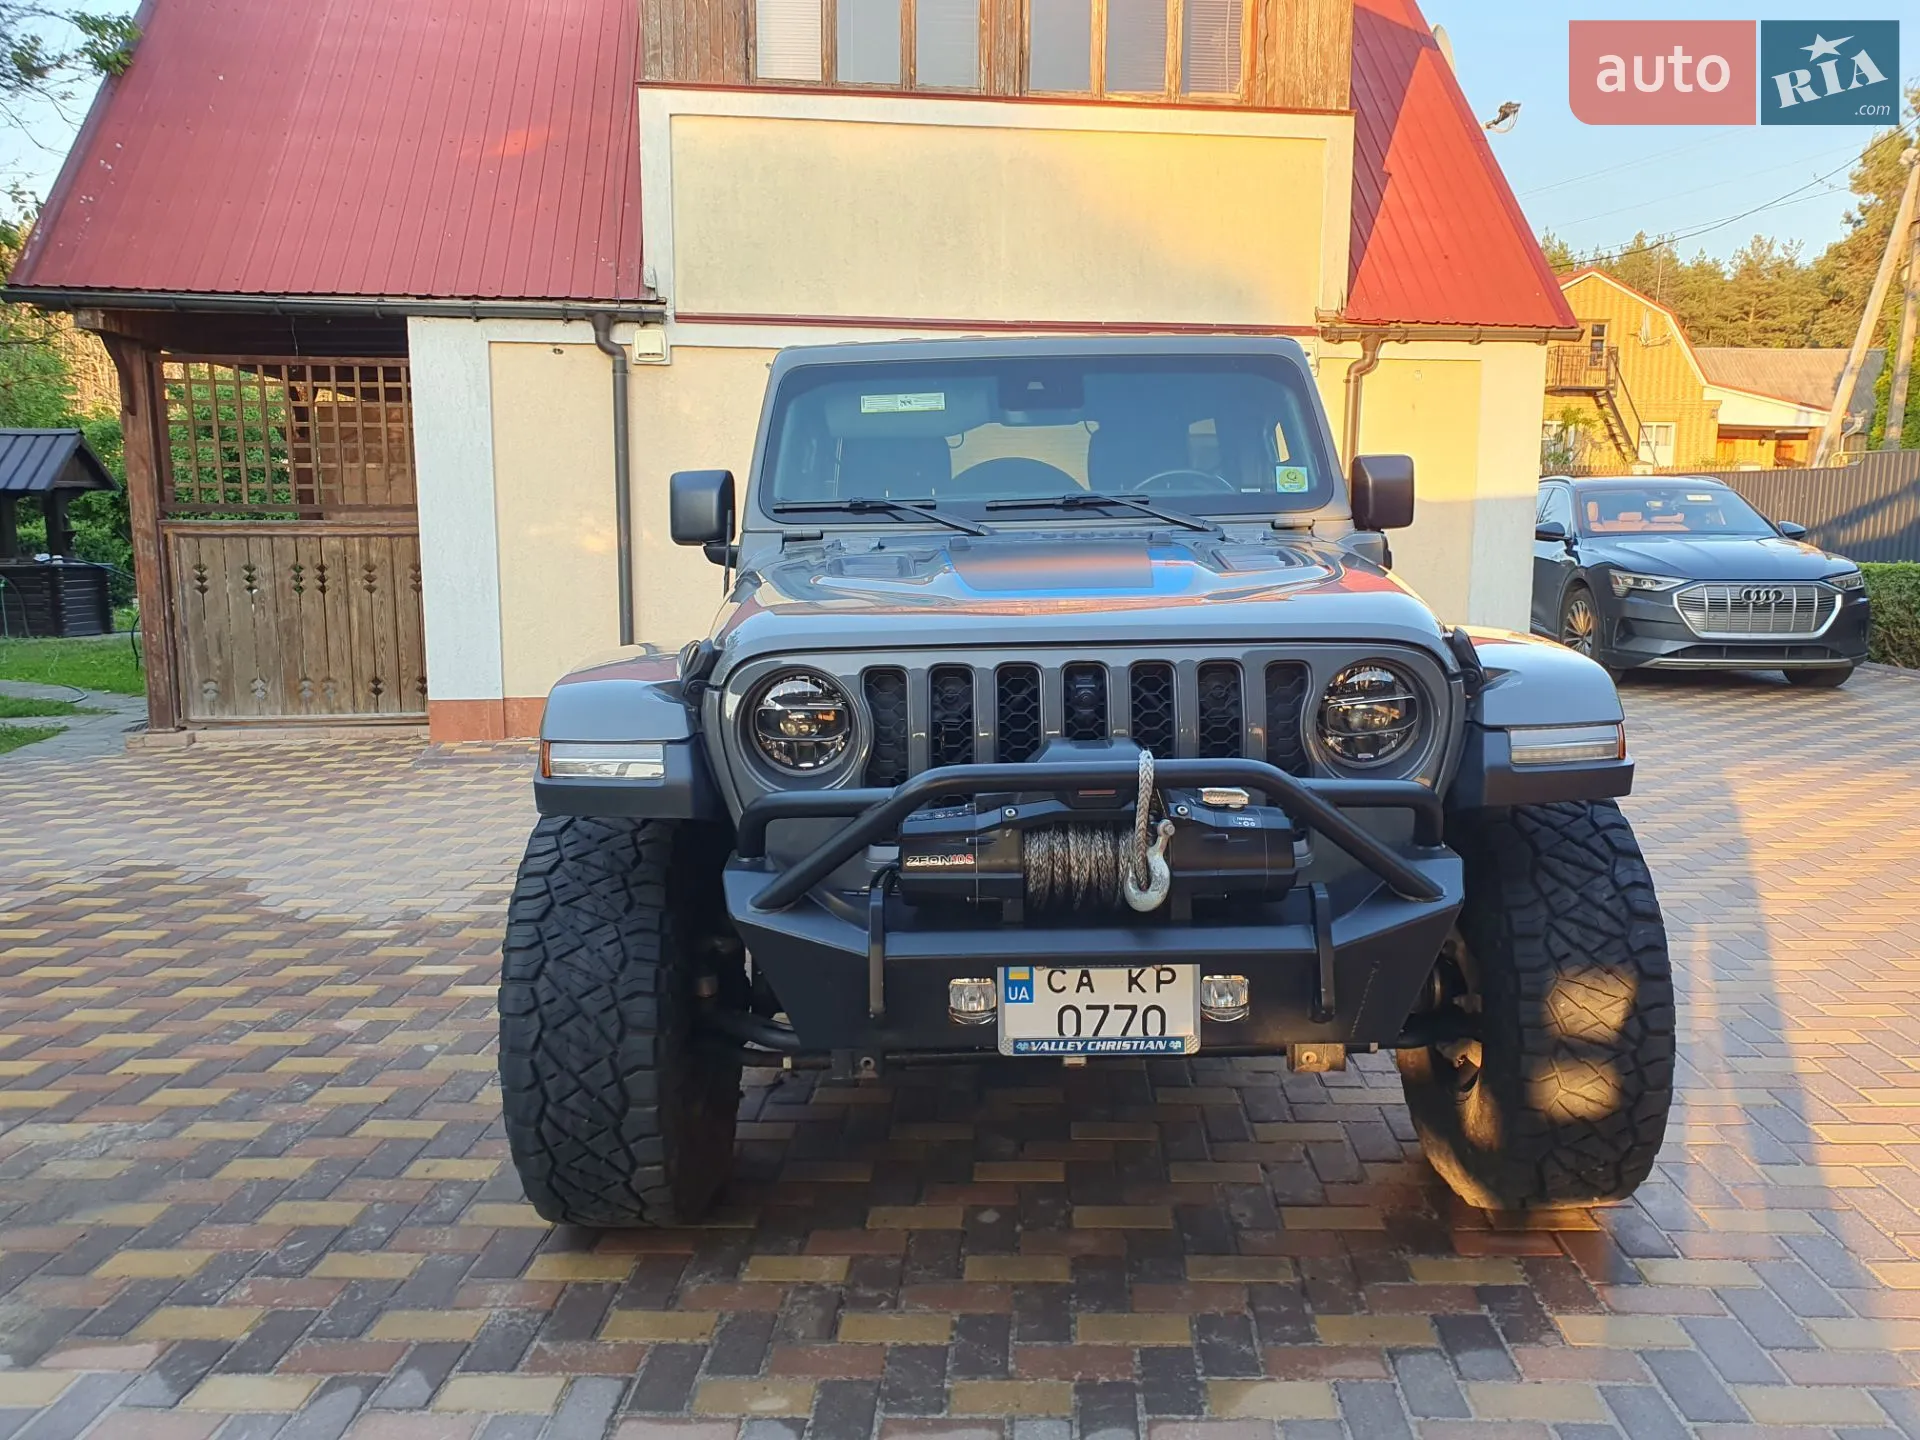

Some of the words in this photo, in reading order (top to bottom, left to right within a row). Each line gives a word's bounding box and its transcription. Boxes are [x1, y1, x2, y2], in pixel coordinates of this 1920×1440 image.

[1047, 969, 1095, 993] CA
[1127, 968, 1177, 993] KP
[1008, 986, 1030, 1001] UA
[1057, 1004, 1167, 1037] 0770
[1030, 1041, 1086, 1052] VALLEY
[1087, 1040, 1167, 1051] CHRISTIAN
